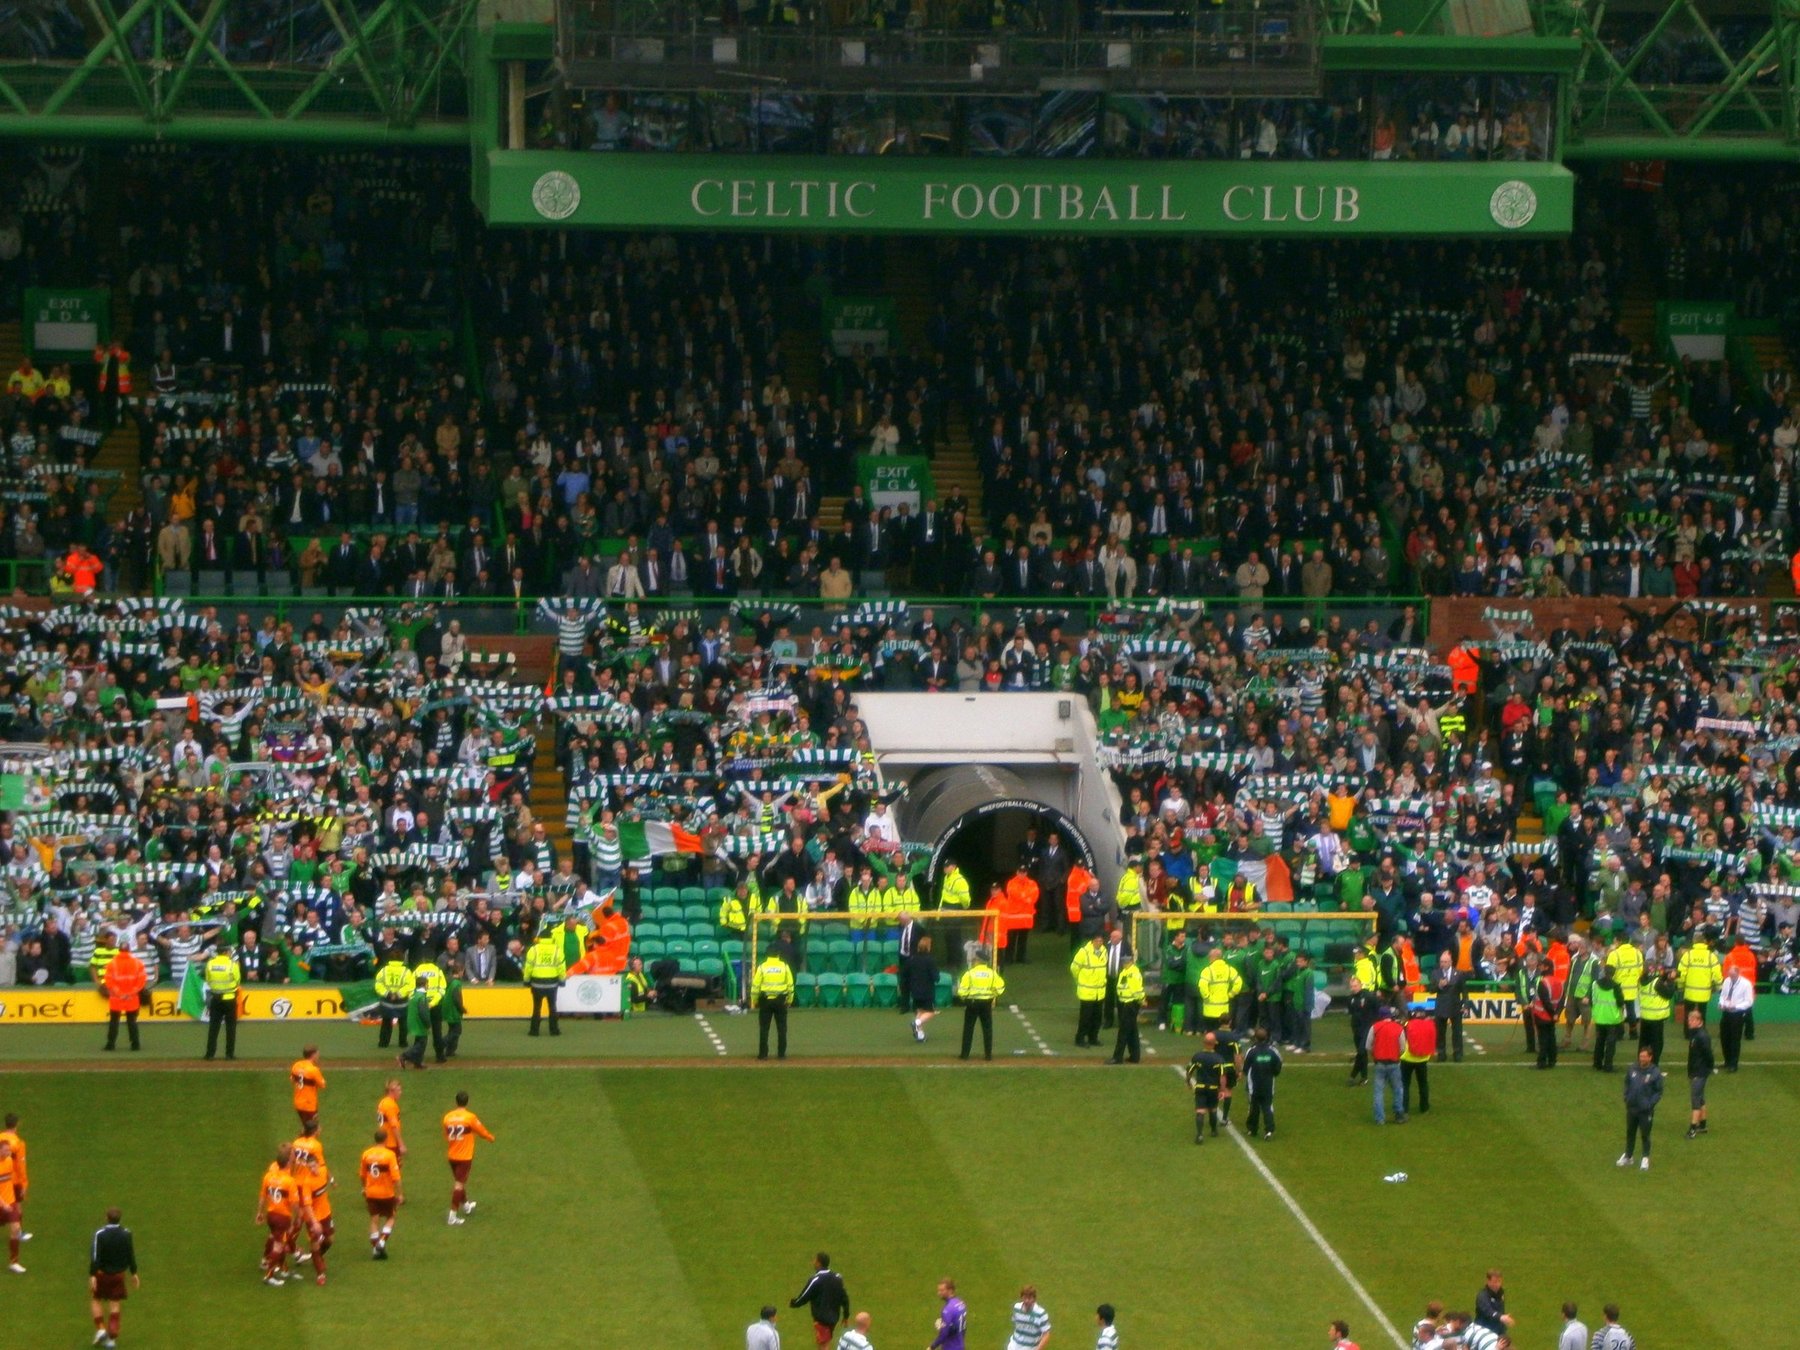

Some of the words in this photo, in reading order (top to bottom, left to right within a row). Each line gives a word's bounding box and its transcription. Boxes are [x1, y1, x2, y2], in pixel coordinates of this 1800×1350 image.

[690, 178, 876, 218] CELTIC
[922, 182, 1187, 222] FOOTBALL
[1222, 184, 1360, 222] CLUB
[48, 297, 81, 309] EXIT
[842, 305, 876, 317] EXIT
[1669, 312, 1702, 325] EXIT
[876, 465, 911, 478] EXIT
[887, 479, 899, 491] G
[447, 1124, 465, 1141] 22
[370, 1161, 380, 1178] 6
